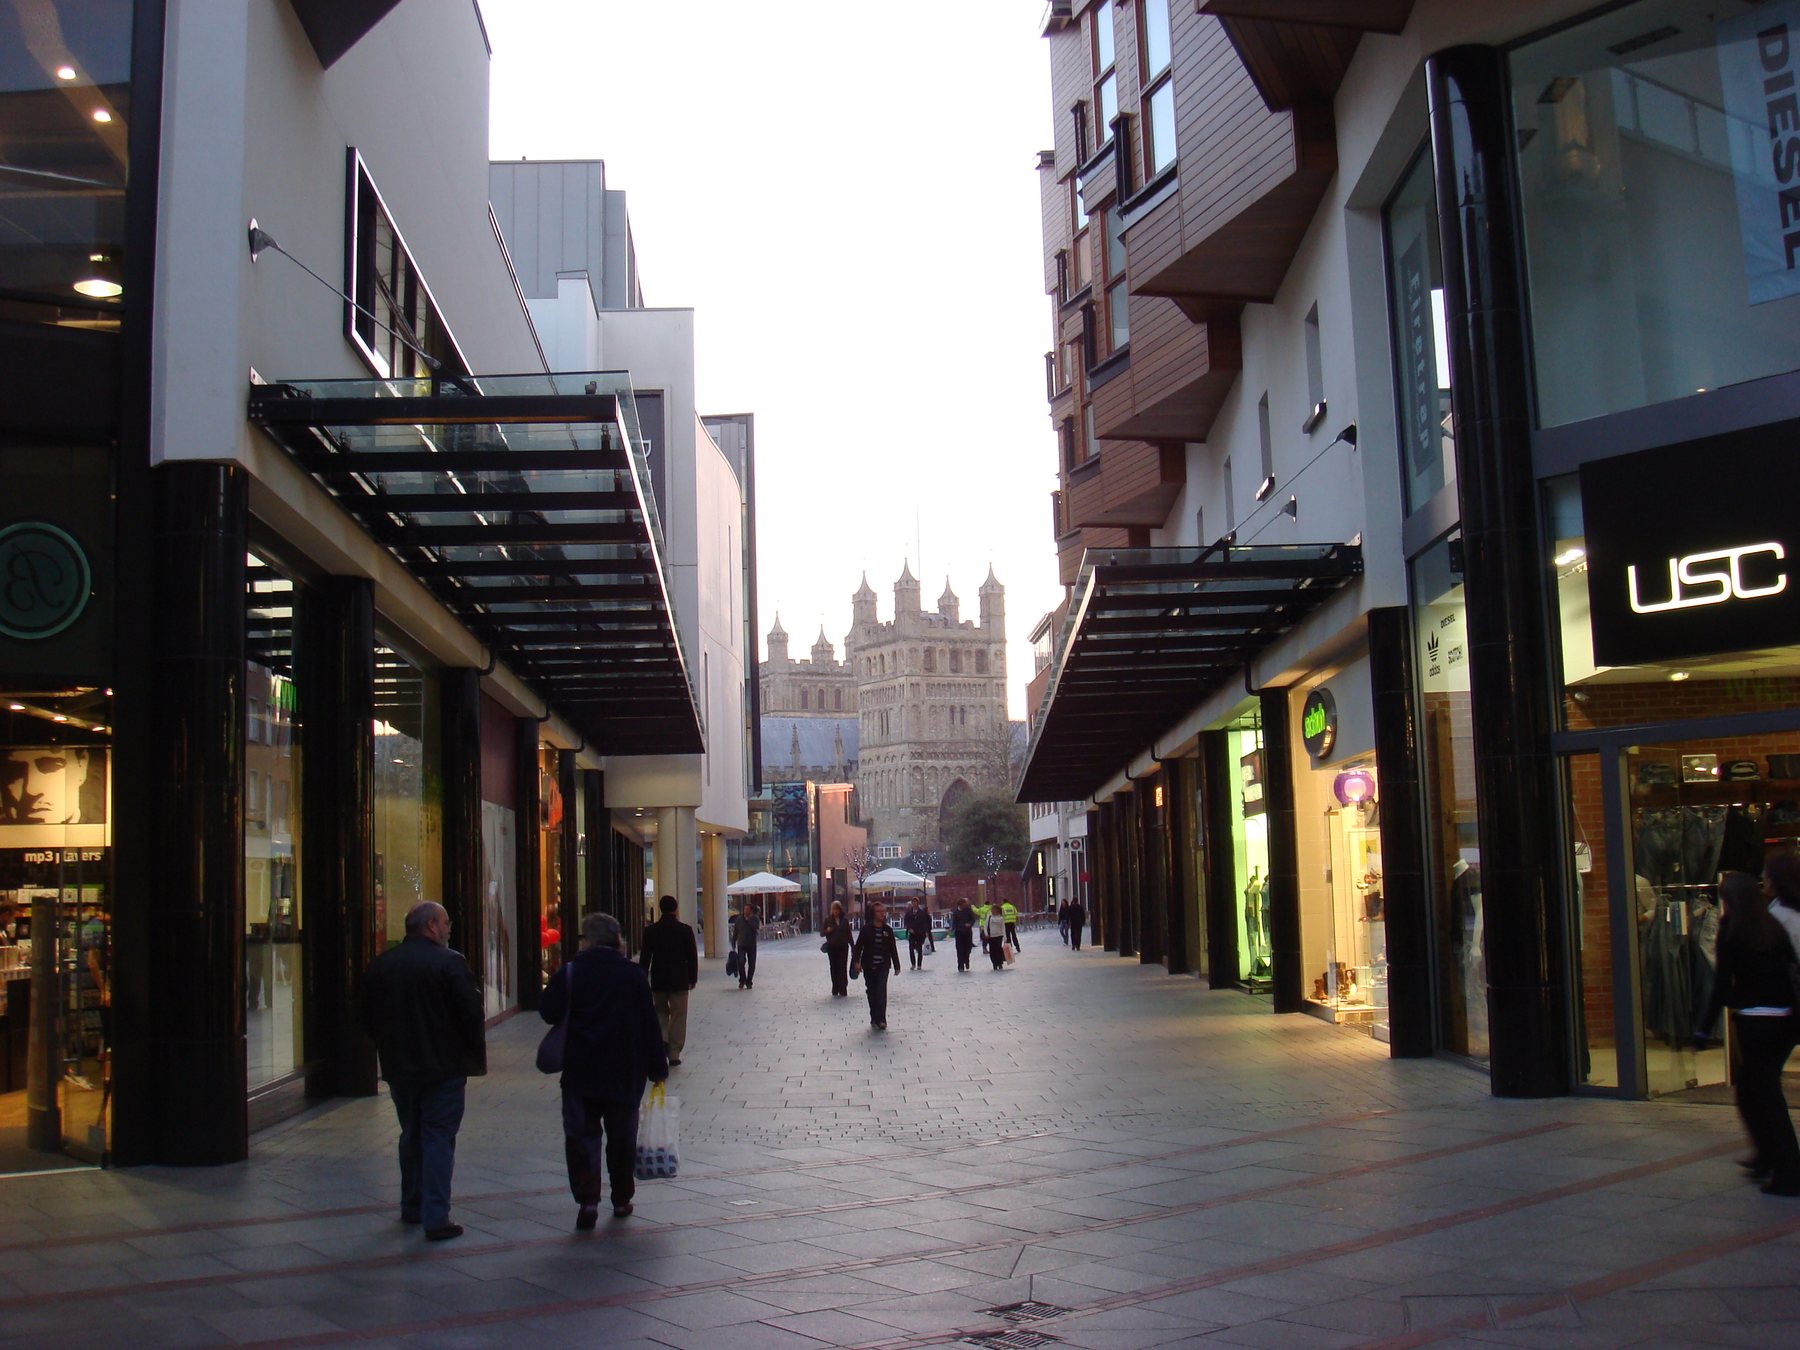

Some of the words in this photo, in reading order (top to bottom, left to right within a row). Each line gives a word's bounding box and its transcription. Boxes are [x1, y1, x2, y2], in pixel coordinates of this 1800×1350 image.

[1757, 23, 1800, 270] DIESEL
[1627, 542, 1787, 614] USC
[24, 850, 54, 864] mp3
